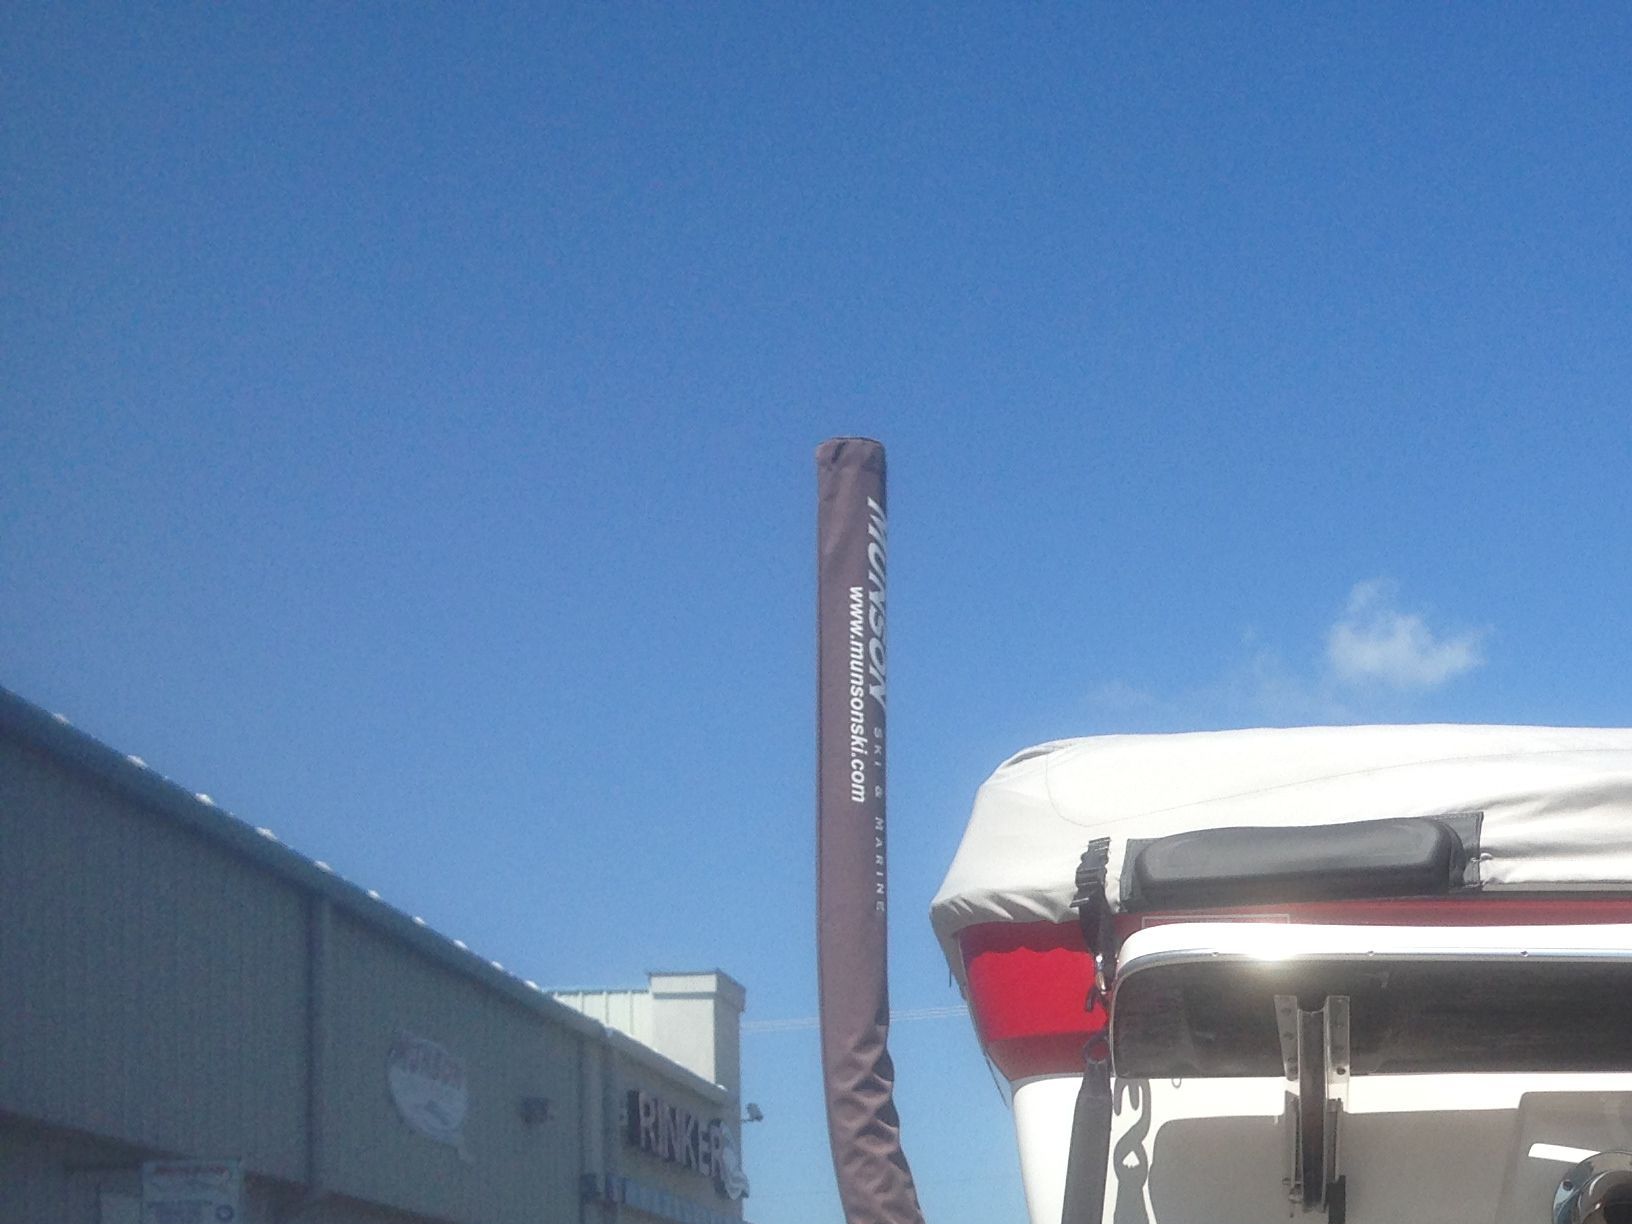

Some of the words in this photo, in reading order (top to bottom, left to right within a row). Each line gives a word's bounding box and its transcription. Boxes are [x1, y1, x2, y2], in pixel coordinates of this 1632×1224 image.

[868, 496, 887, 709] MUNSON
[850, 586, 868, 803] www.munsonski.com
[874, 726, 883, 766] SKI
[875, 816, 885, 911] MARINE
[638, 1087, 724, 1177] RINKER
